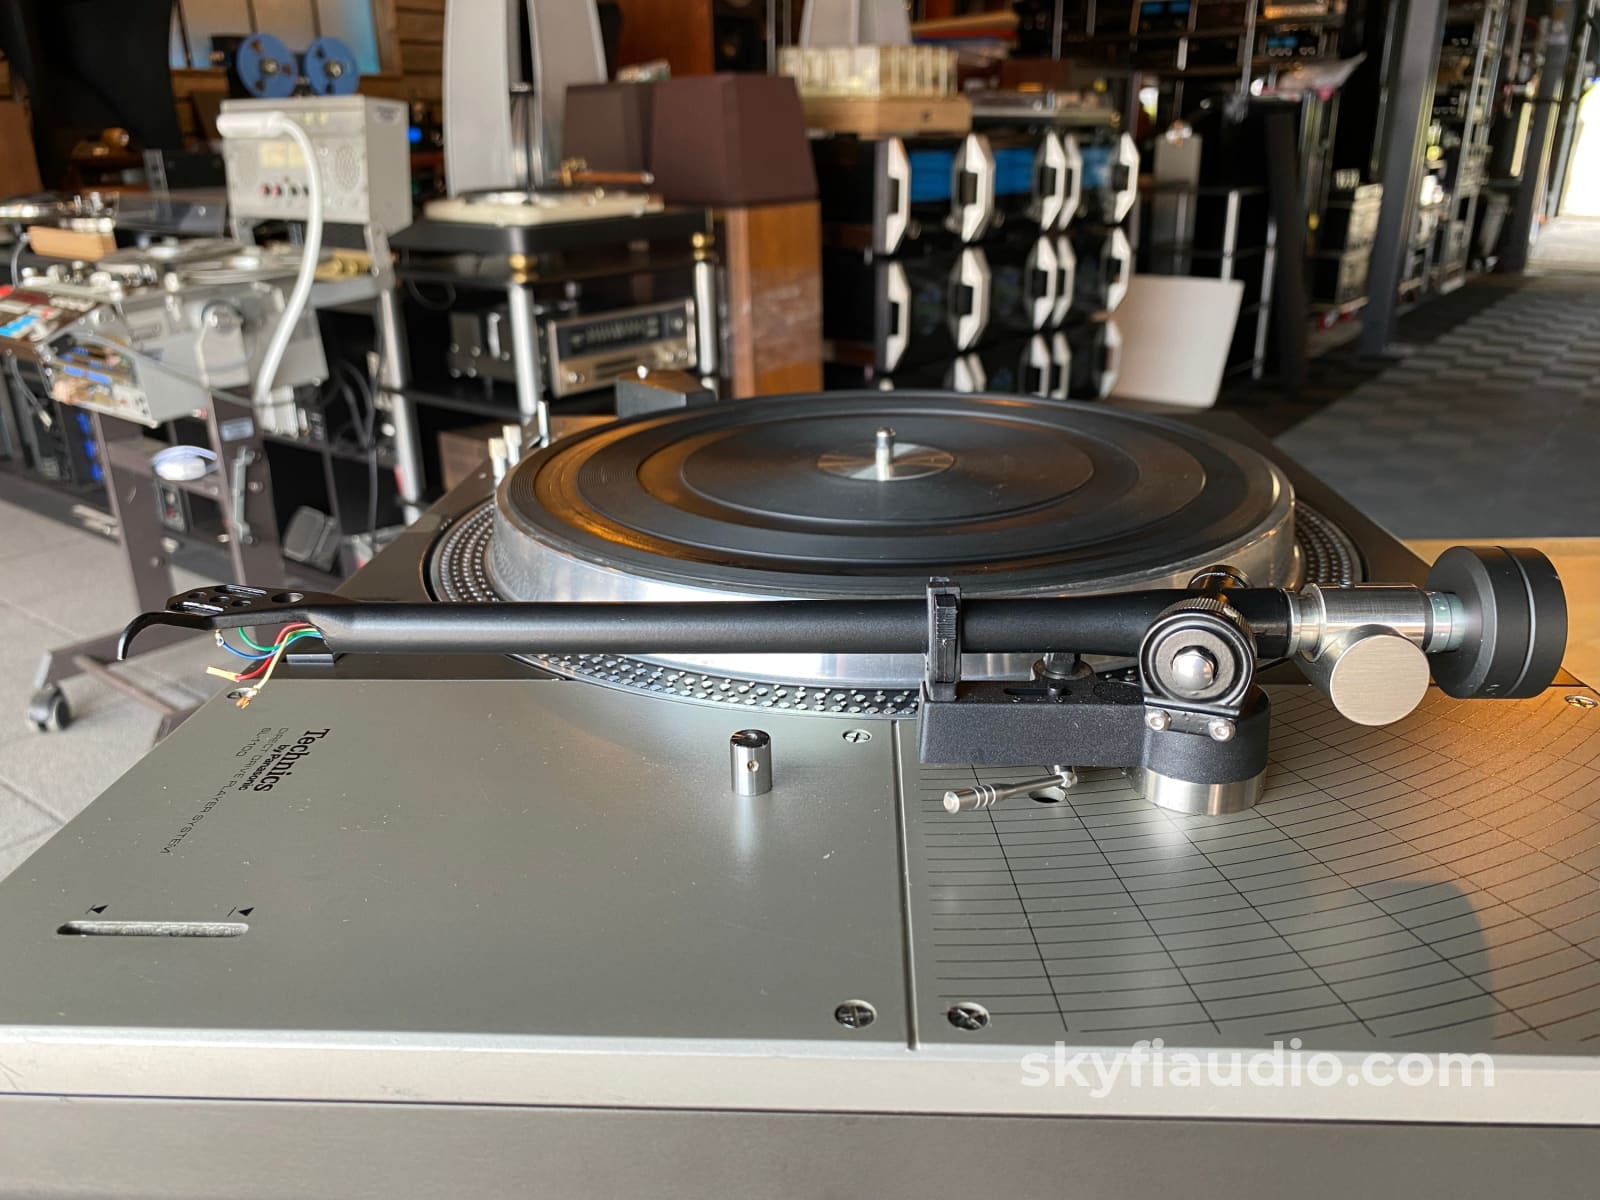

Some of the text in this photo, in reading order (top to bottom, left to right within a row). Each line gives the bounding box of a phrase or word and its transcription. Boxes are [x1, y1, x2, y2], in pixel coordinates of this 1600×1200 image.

[234, 754, 263, 779] DRIVE
[238, 744, 292, 791] by Panasonic
[253, 728, 331, 792] Technics
[200, 780, 238, 813] PLAYER
[160, 814, 204, 854] SYSTEM
